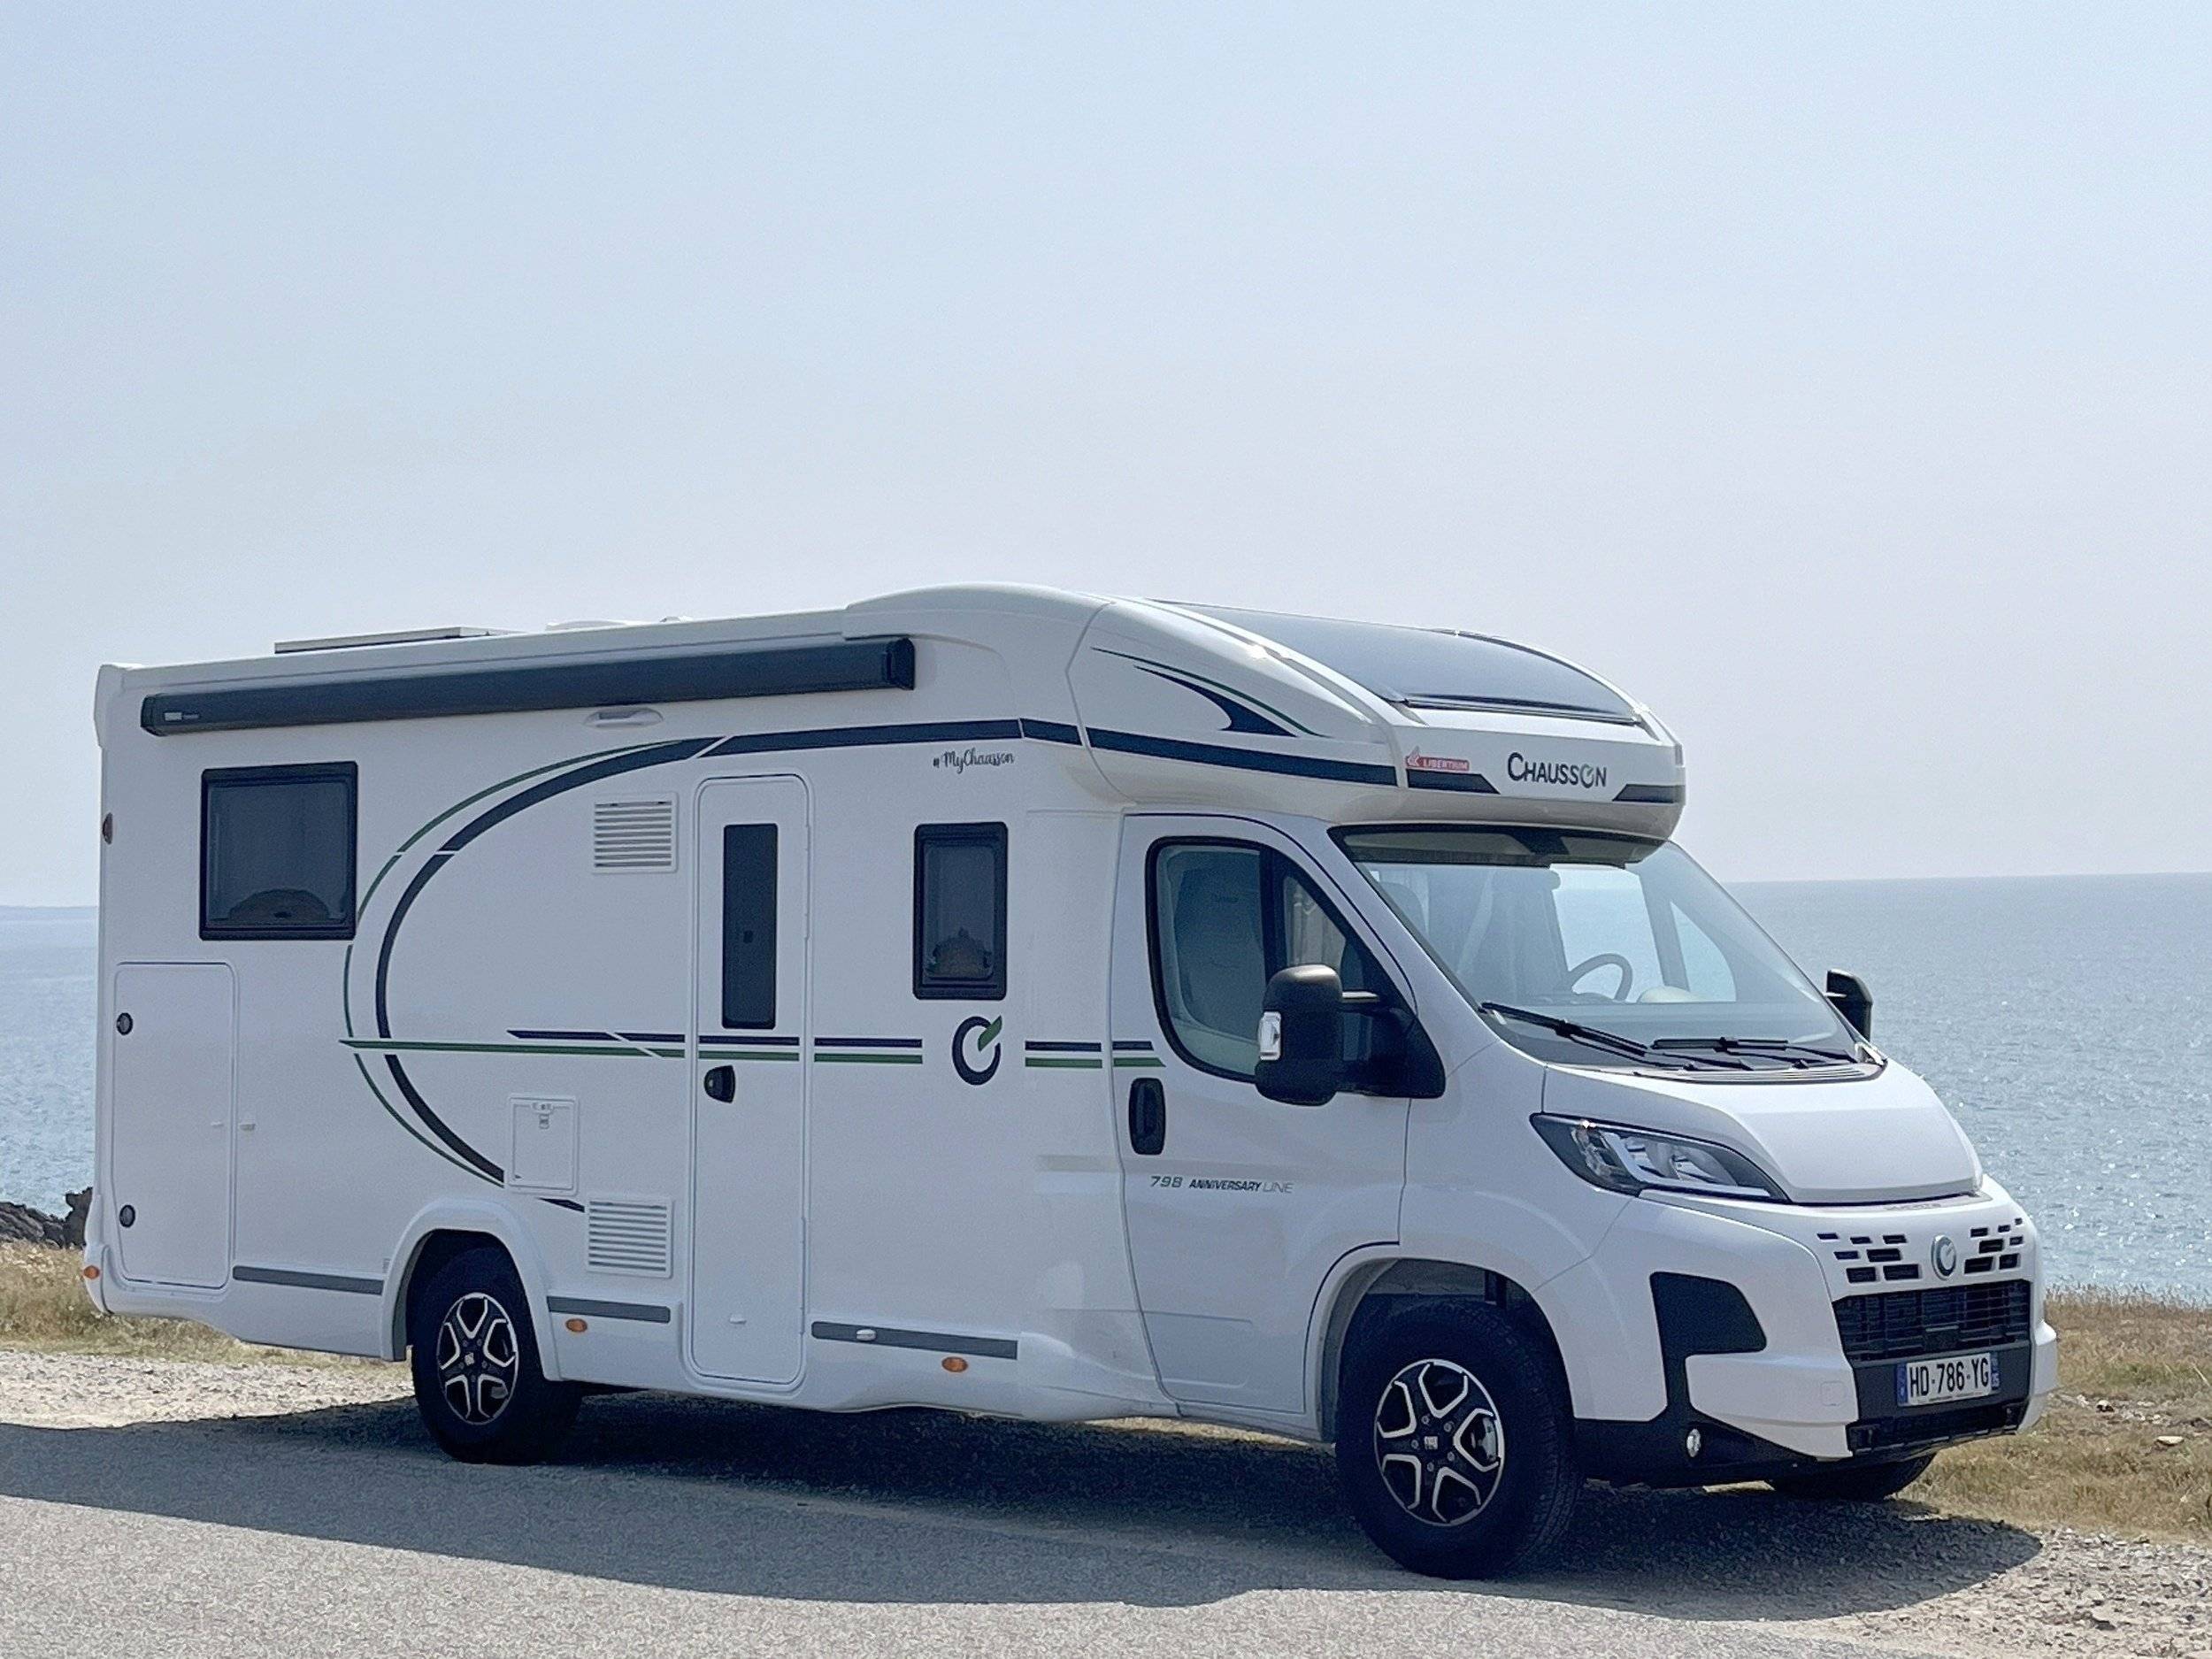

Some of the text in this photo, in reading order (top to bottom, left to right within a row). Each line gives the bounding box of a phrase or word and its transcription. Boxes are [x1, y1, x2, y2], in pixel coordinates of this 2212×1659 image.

[1507, 752, 1607, 788] CHAUSSON
[1150, 1175, 1294, 1194] 798 ANNIVERSARY LINE
[1909, 1357, 1989, 1398] HD-786-YG
